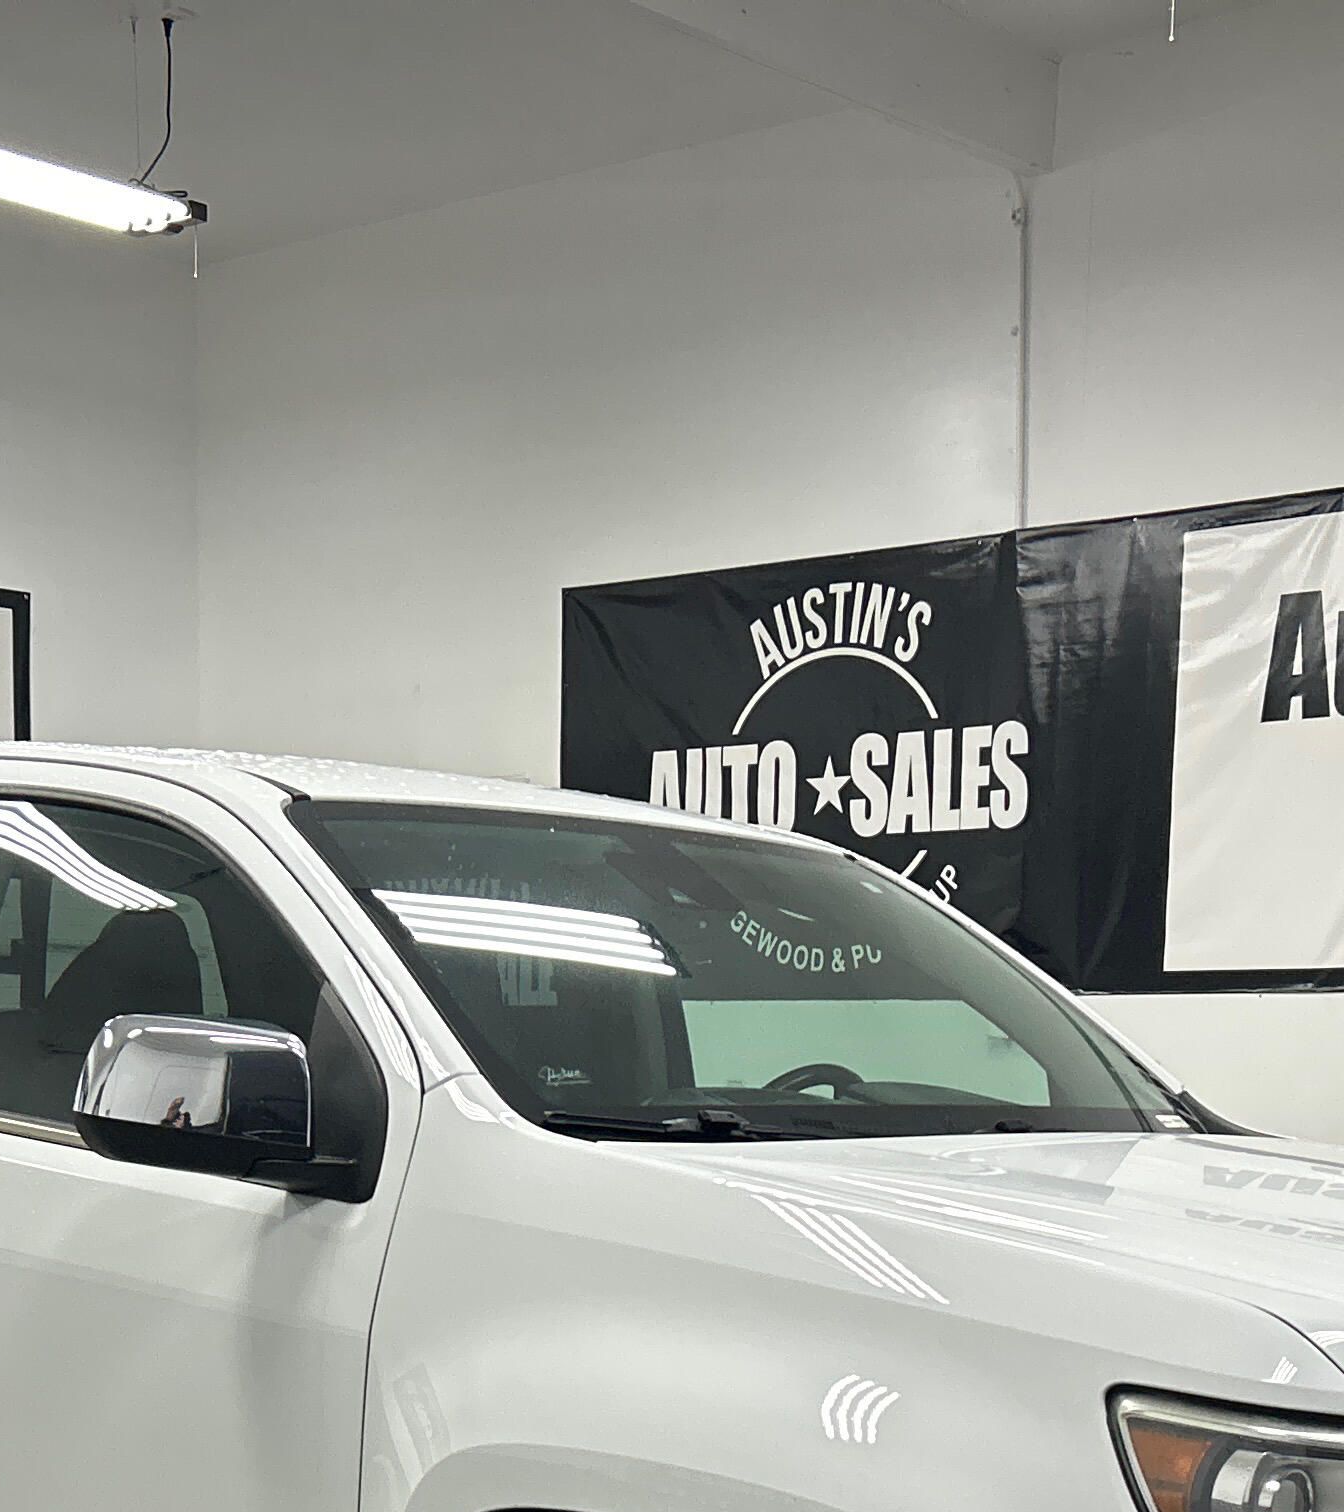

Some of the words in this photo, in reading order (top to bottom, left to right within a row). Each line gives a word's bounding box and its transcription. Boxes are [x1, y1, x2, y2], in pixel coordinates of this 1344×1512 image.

[749, 582, 932, 680] AUSTIN'S
[649, 740, 797, 833] AUTO
[850, 721, 1029, 838] SALES
[730, 910, 825, 972] GEWOOD
[831, 947, 846, 973] &
[929, 864, 958, 904] UP
